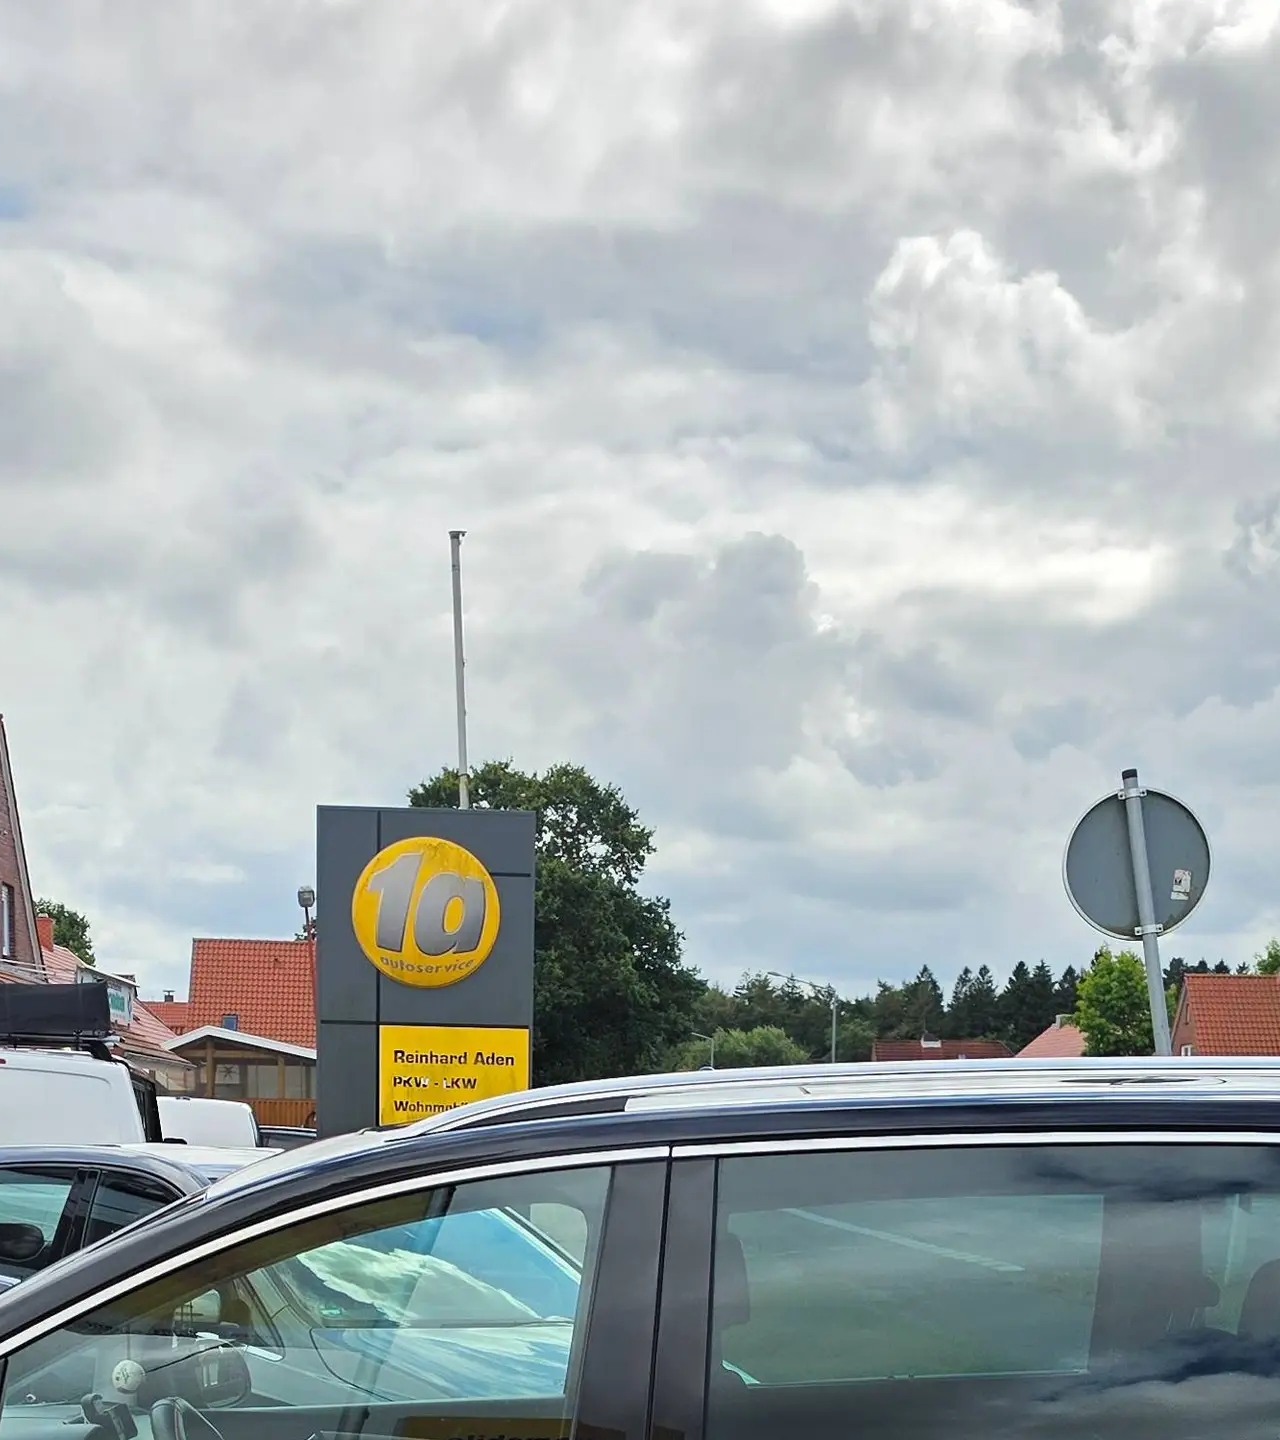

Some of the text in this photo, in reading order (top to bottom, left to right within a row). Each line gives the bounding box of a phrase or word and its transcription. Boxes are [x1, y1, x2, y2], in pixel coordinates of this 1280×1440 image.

[368, 852, 486, 957] 1a
[379, 955, 475, 975] autoservice
[393, 1049, 515, 1067] Reinhard Aden
[392, 1076, 428, 1088] PKW
[442, 1077, 478, 1090] LKW
